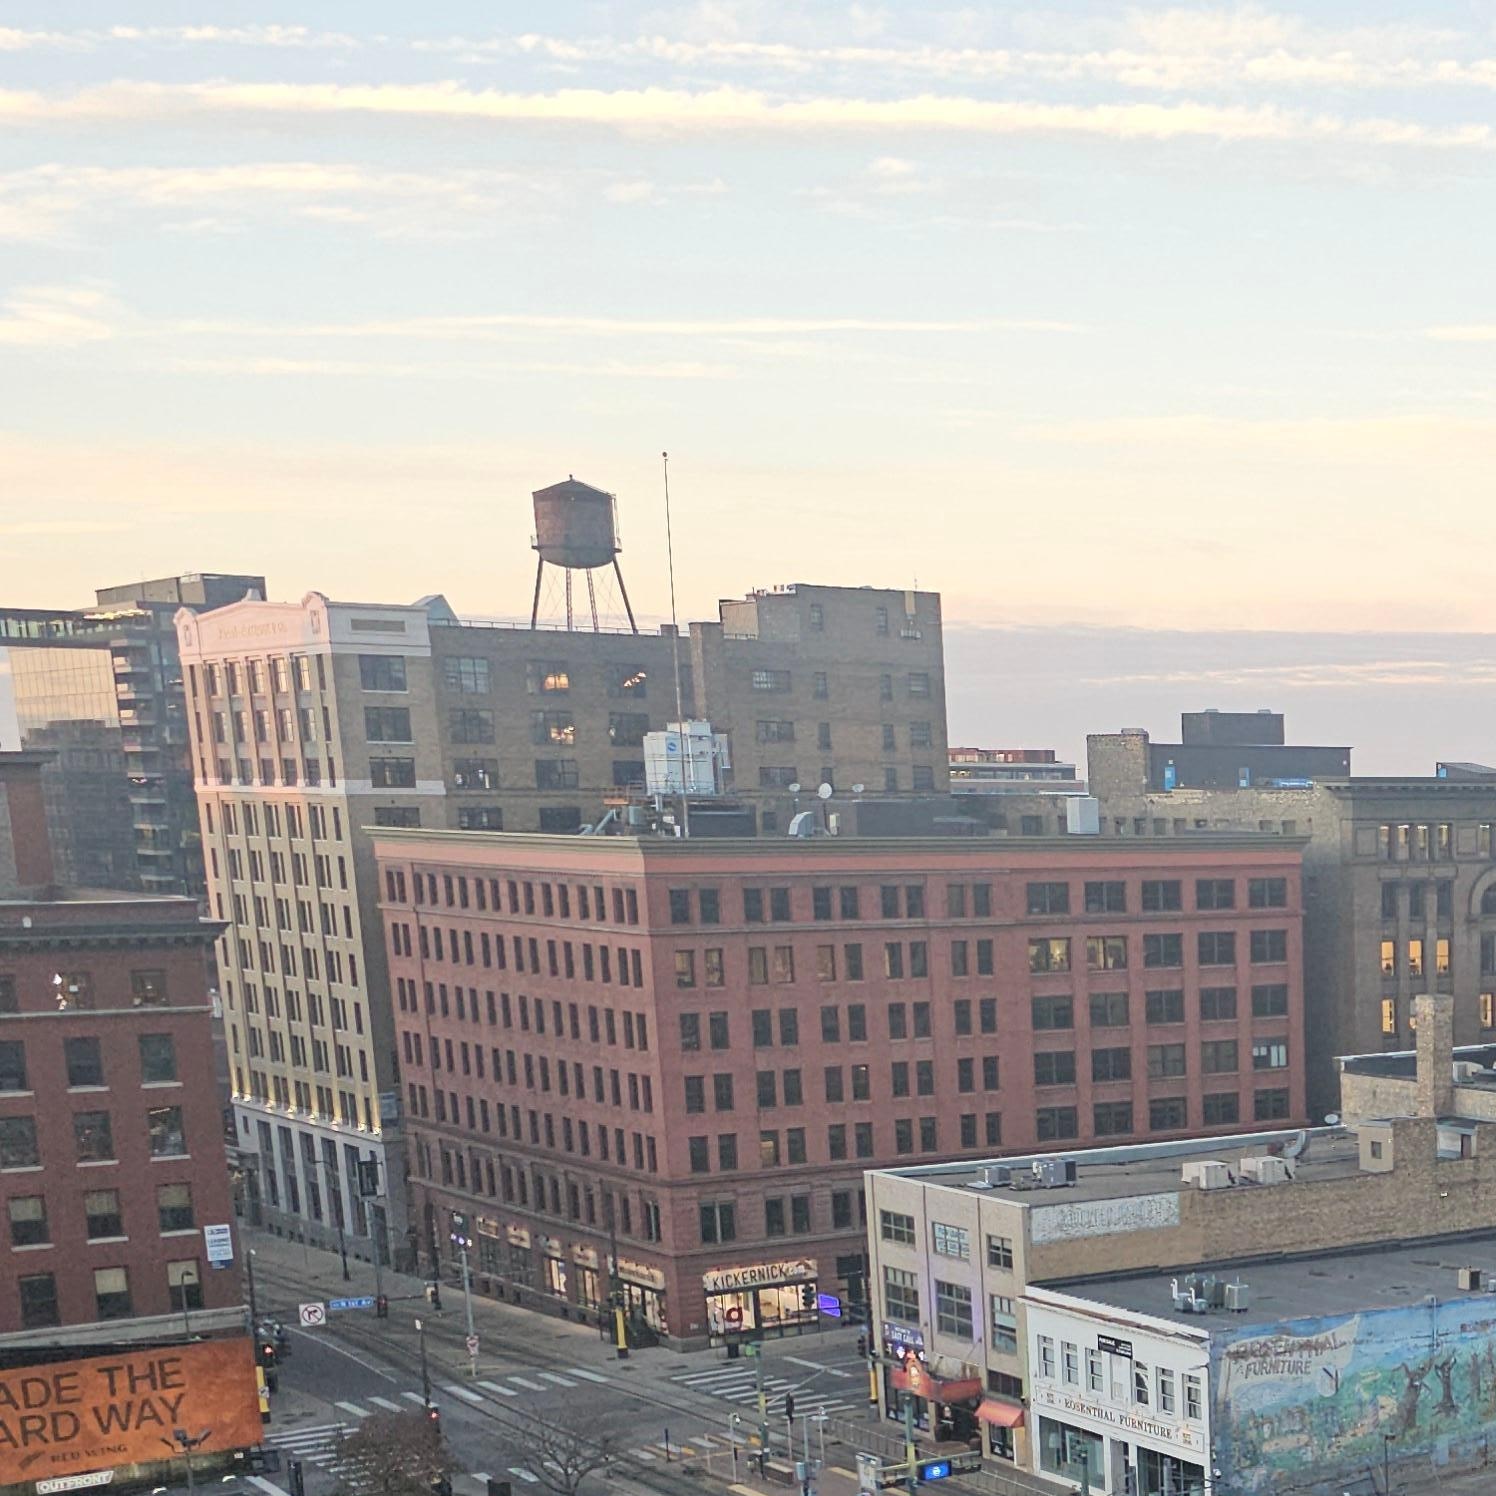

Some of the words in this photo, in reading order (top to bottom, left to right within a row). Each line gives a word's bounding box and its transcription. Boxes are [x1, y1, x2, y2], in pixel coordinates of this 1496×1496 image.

[713, 1264, 787, 1289] KICKERNICK
[97, 1357, 186, 1398] THE
[1245, 1360, 1312, 1379] FURNITURE
[93, 1393, 185, 1435] WAY
[1064, 1398, 1116, 1423] ROSENTHAL
[1119, 1415, 1173, 1440] FURNITURE
[40, 1472, 111, 1492] OUTFRONT
